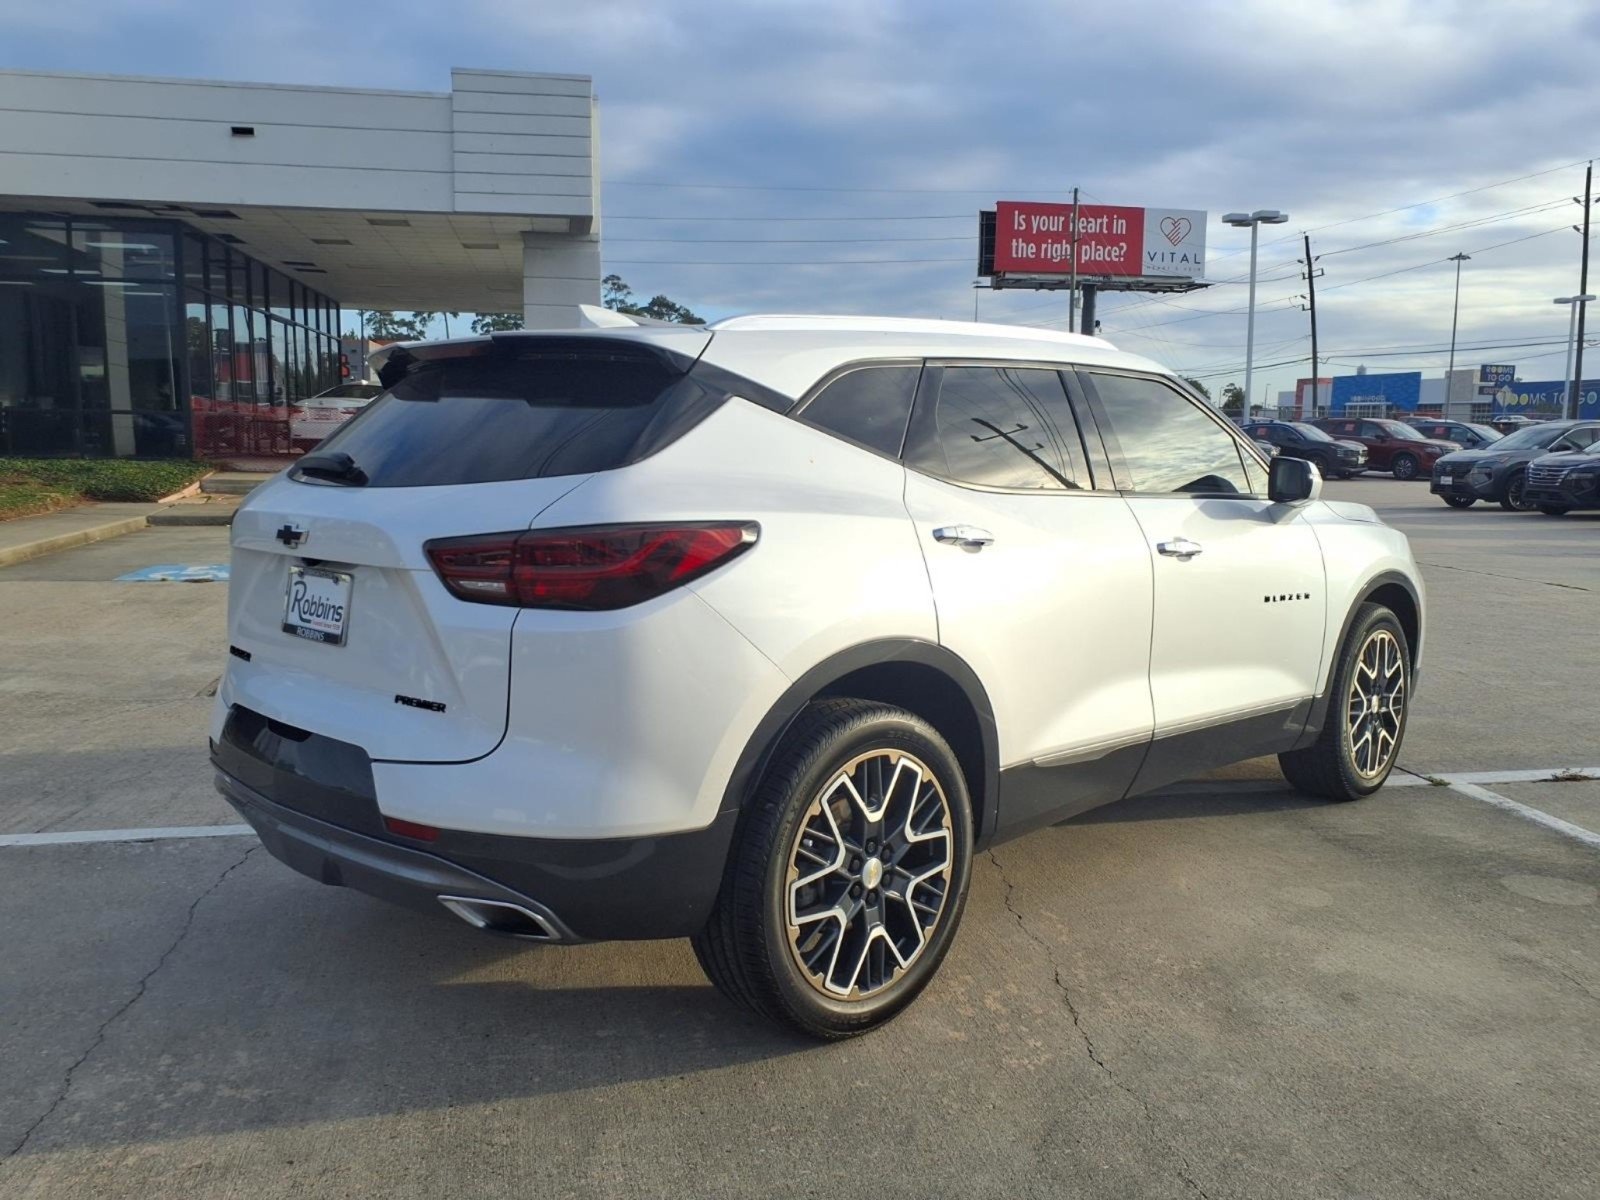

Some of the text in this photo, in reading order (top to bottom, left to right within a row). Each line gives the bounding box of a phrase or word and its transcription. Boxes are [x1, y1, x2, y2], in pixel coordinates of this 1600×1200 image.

[1014, 210, 1026, 231] Is
[1031, 215, 1065, 234] your
[1113, 215, 1127, 235] in
[1012, 238, 1127, 263] the righ place?
[1147, 250, 1201, 264] VITAL
[1486, 366, 1513, 374] ROOMS
[1498, 374, 1511, 382] GO
[291, 580, 344, 624] Robbins
[296, 626, 325, 641] ROBBINS
[394, 694, 447, 713] PREMIER
